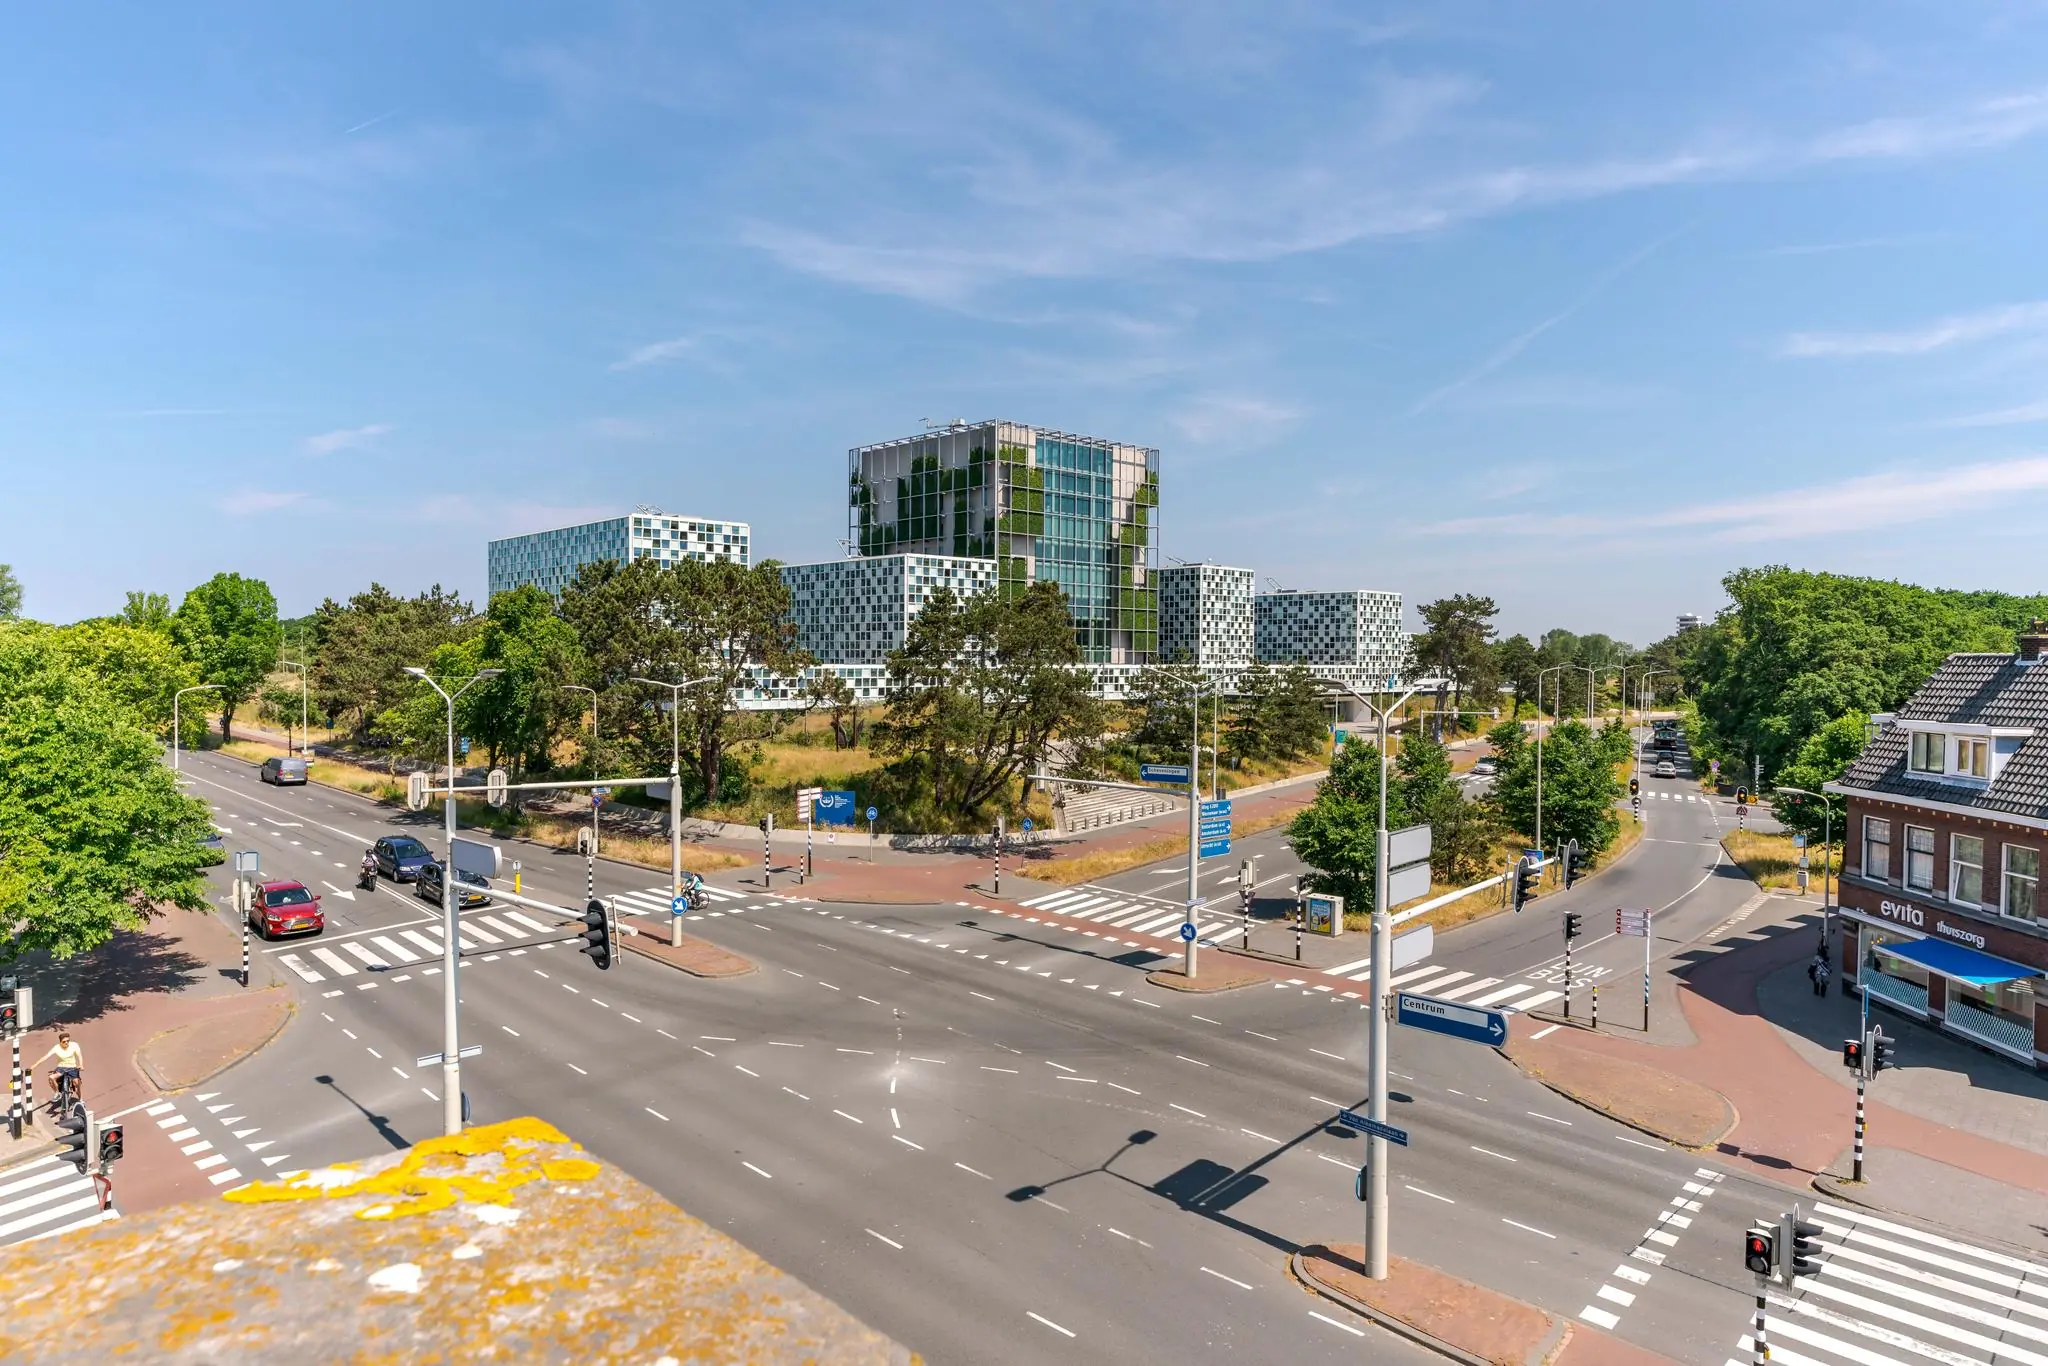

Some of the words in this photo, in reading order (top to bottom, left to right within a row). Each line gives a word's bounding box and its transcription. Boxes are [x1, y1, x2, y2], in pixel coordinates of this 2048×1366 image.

[1881, 900, 1924, 927] evita
[1936, 920, 1985, 949] thuiszorg
[1550, 961, 1613, 977] LIJN
[1525, 969, 1592, 988] BUS
[1403, 998, 1445, 1015] Centrum
